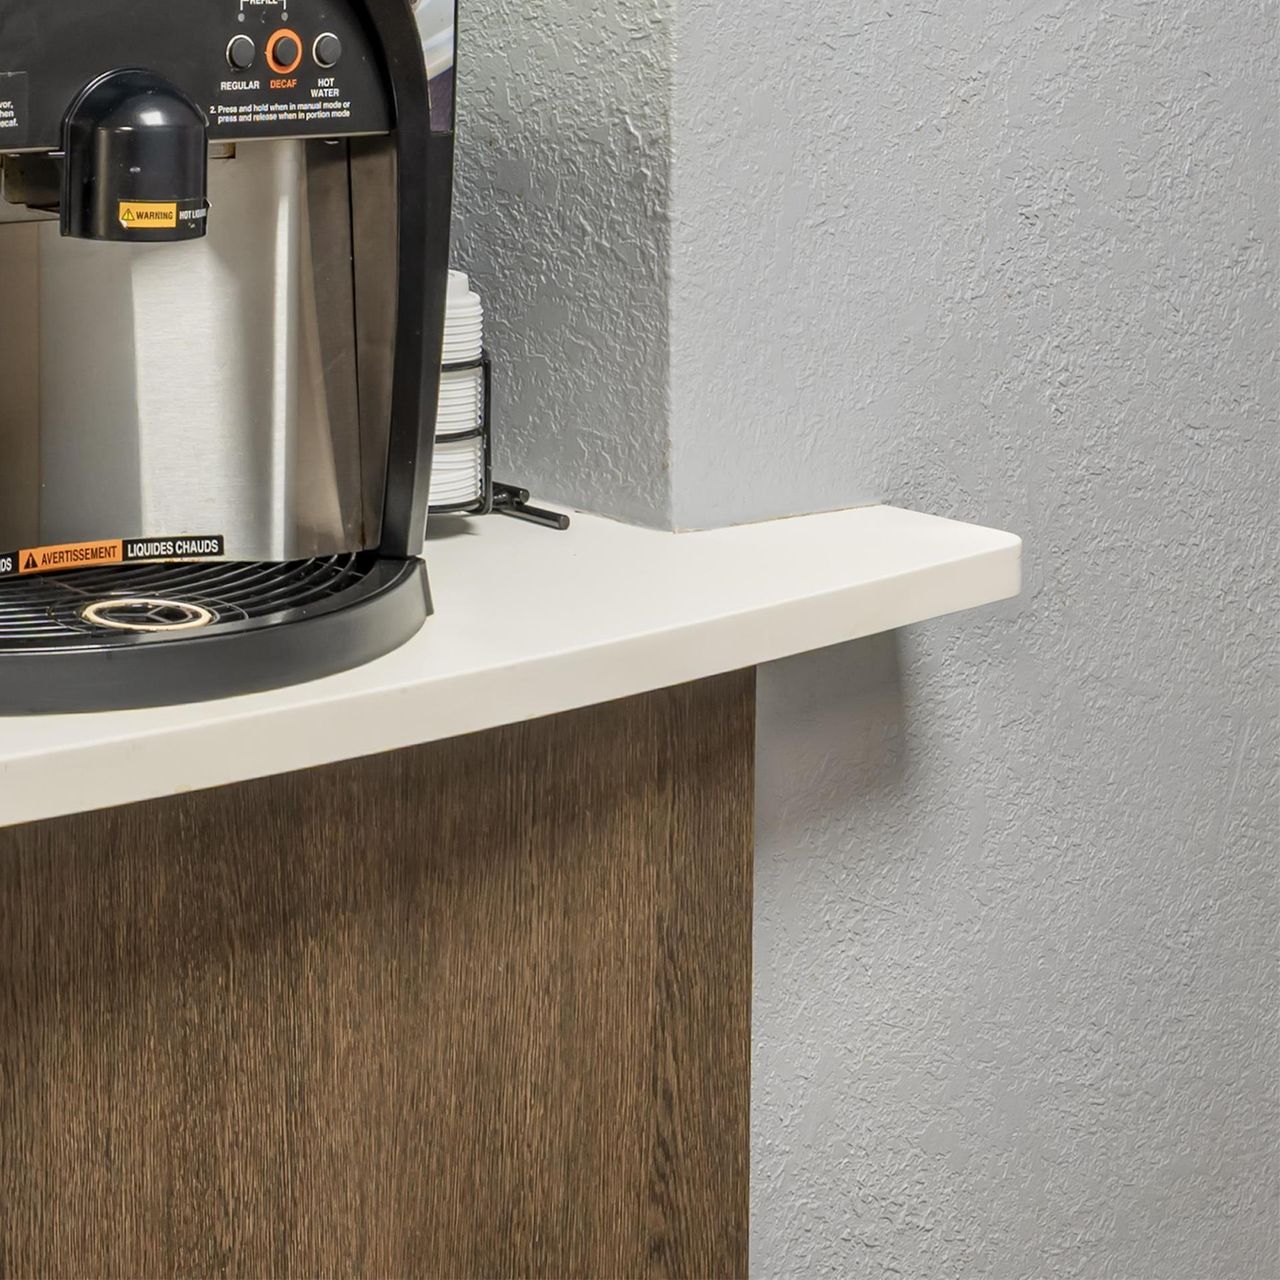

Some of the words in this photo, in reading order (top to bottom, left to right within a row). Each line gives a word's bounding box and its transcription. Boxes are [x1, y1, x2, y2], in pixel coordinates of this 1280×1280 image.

[220, 80, 260, 91] REGULAR
[269, 78, 297, 89] DECAF
[317, 77, 335, 87] HOT
[310, 88, 340, 98] WATER
[217, 105, 237, 114] Press
[238, 104, 252, 113] and
[253, 103, 269, 112] hold
[269, 102, 289, 111] when
[289, 102, 296, 110] in
[297, 101, 322, 110] manual
[323, 100, 342, 109] mode
[217, 115, 237, 125] press
[238, 113, 252, 122] and
[253, 112, 277, 121] release
[278, 111, 297, 120] when
[298, 111, 305, 119] in
[306, 109, 330, 120] portion
[331, 109, 350, 118] mode
[136, 211, 173, 220] WARNING
[41, 545, 117, 566] AVERTISSEMENT
[127, 542, 174, 558] LIQUIDES
[174, 539, 219, 554] CHAUDS
